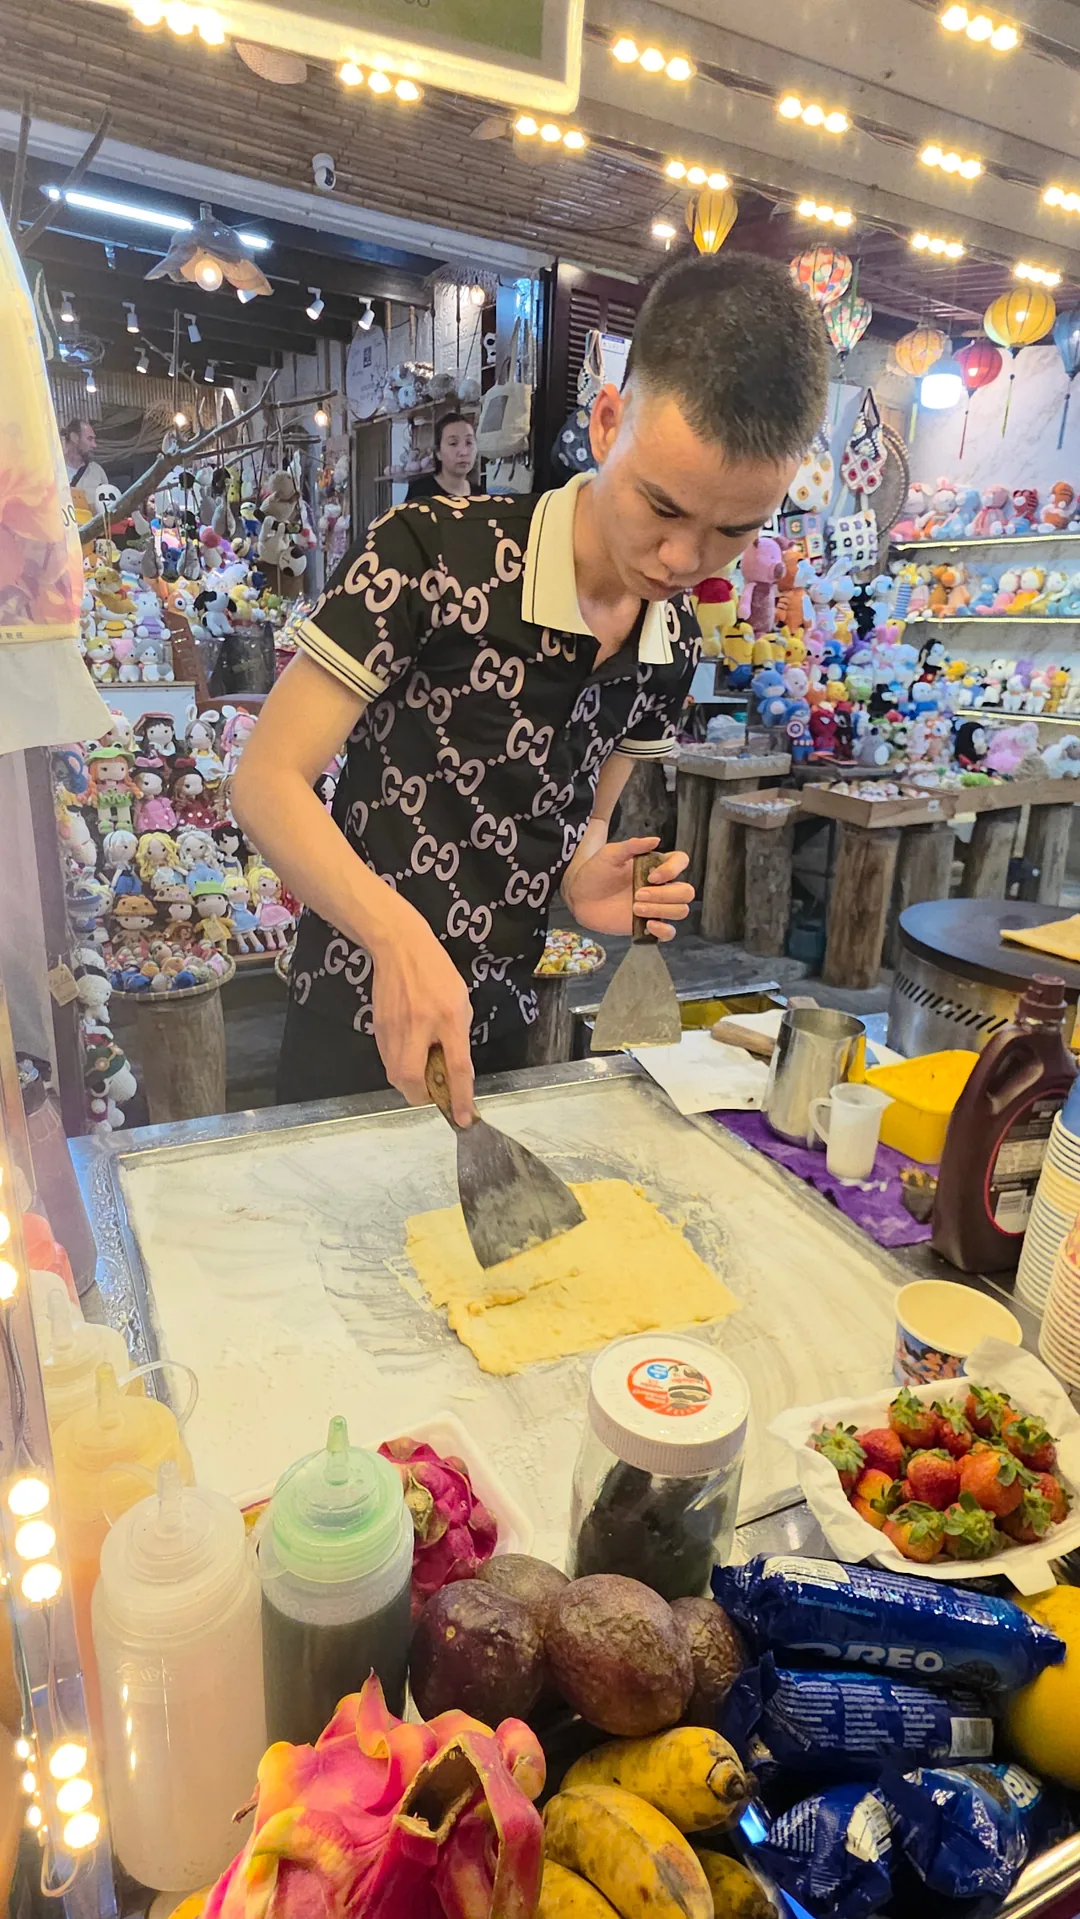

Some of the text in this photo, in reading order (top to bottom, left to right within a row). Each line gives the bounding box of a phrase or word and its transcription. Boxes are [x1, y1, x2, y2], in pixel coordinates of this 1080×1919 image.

[495, 538, 528, 582] G
[470, 648, 525, 700] GG
[471, 813, 518, 856] GG
[411, 835, 460, 881] GG
[505, 870, 550, 908] GG
[446, 899, 493, 944] GG
